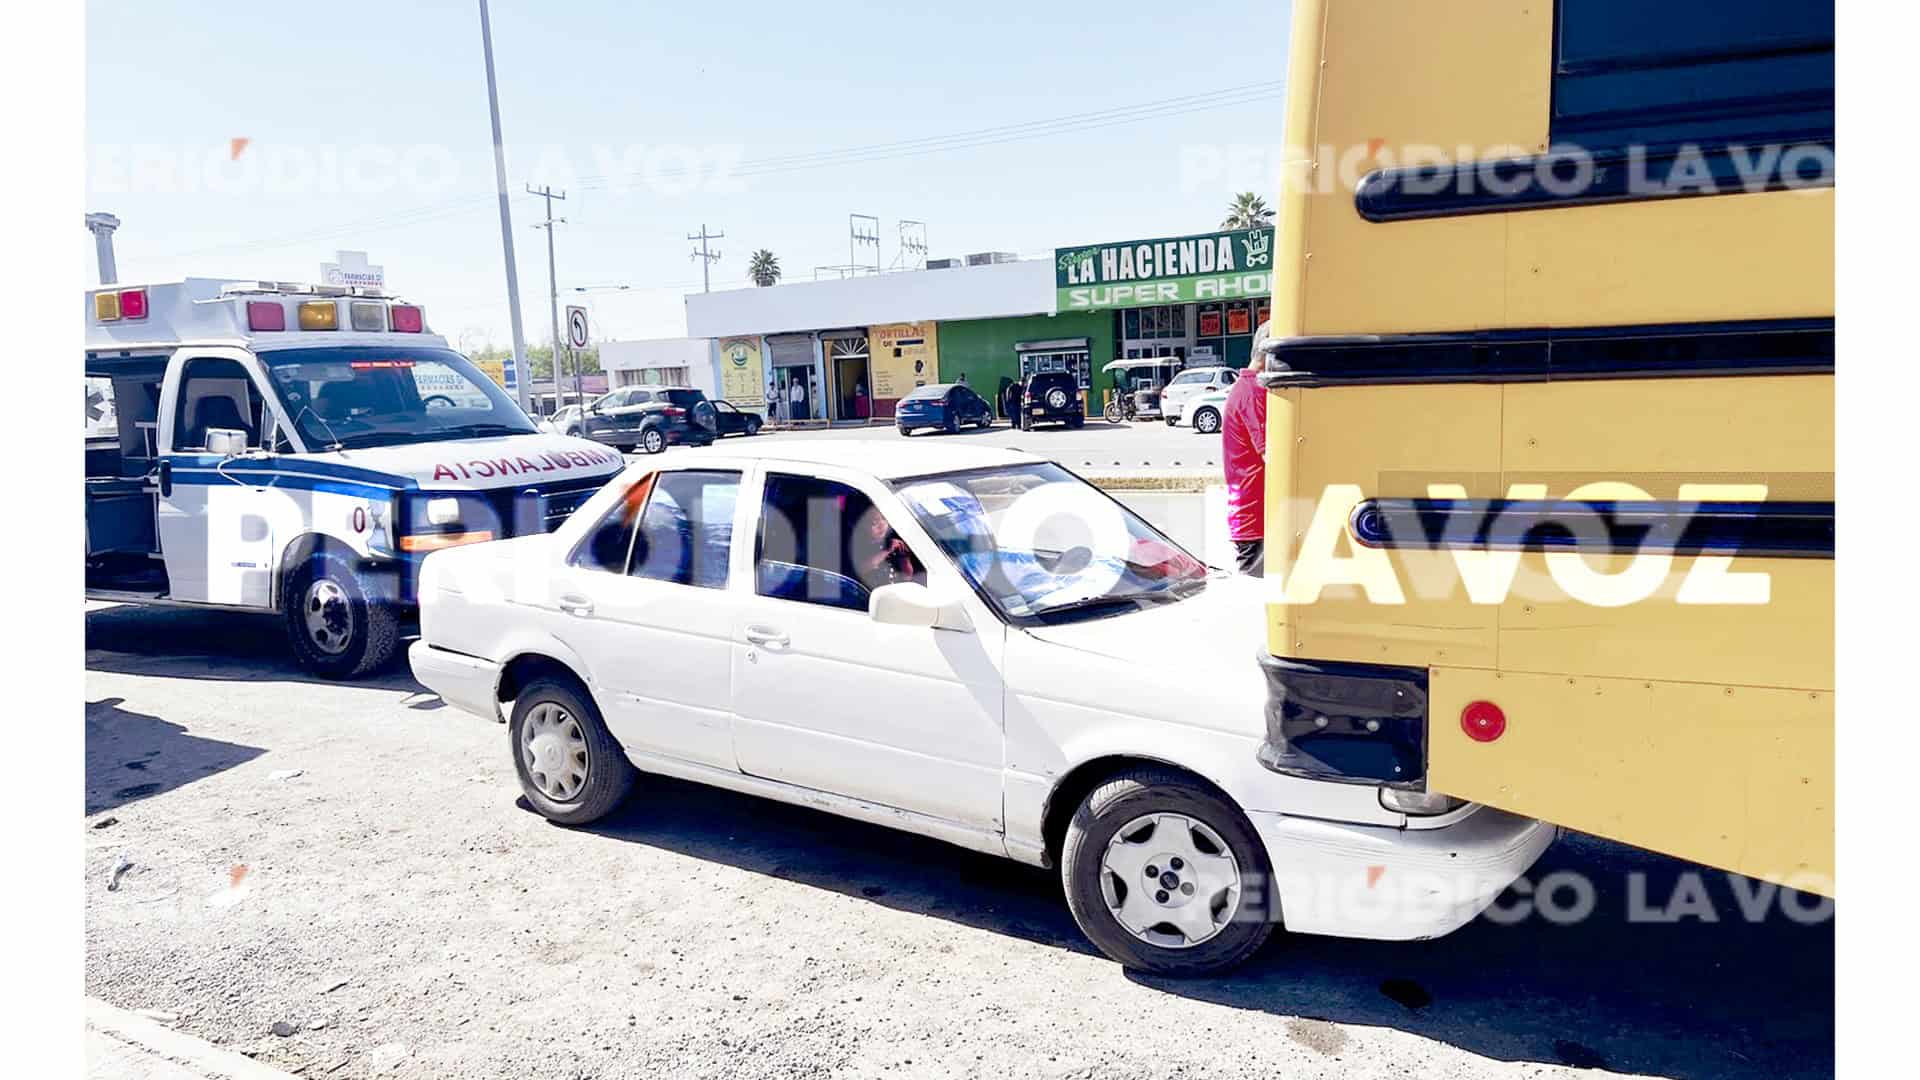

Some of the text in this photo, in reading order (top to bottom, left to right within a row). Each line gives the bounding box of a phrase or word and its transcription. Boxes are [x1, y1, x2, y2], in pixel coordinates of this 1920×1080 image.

[1068, 237, 1235, 284] LA HACIENDA
[1069, 275, 1271, 307] SUPER AHO
